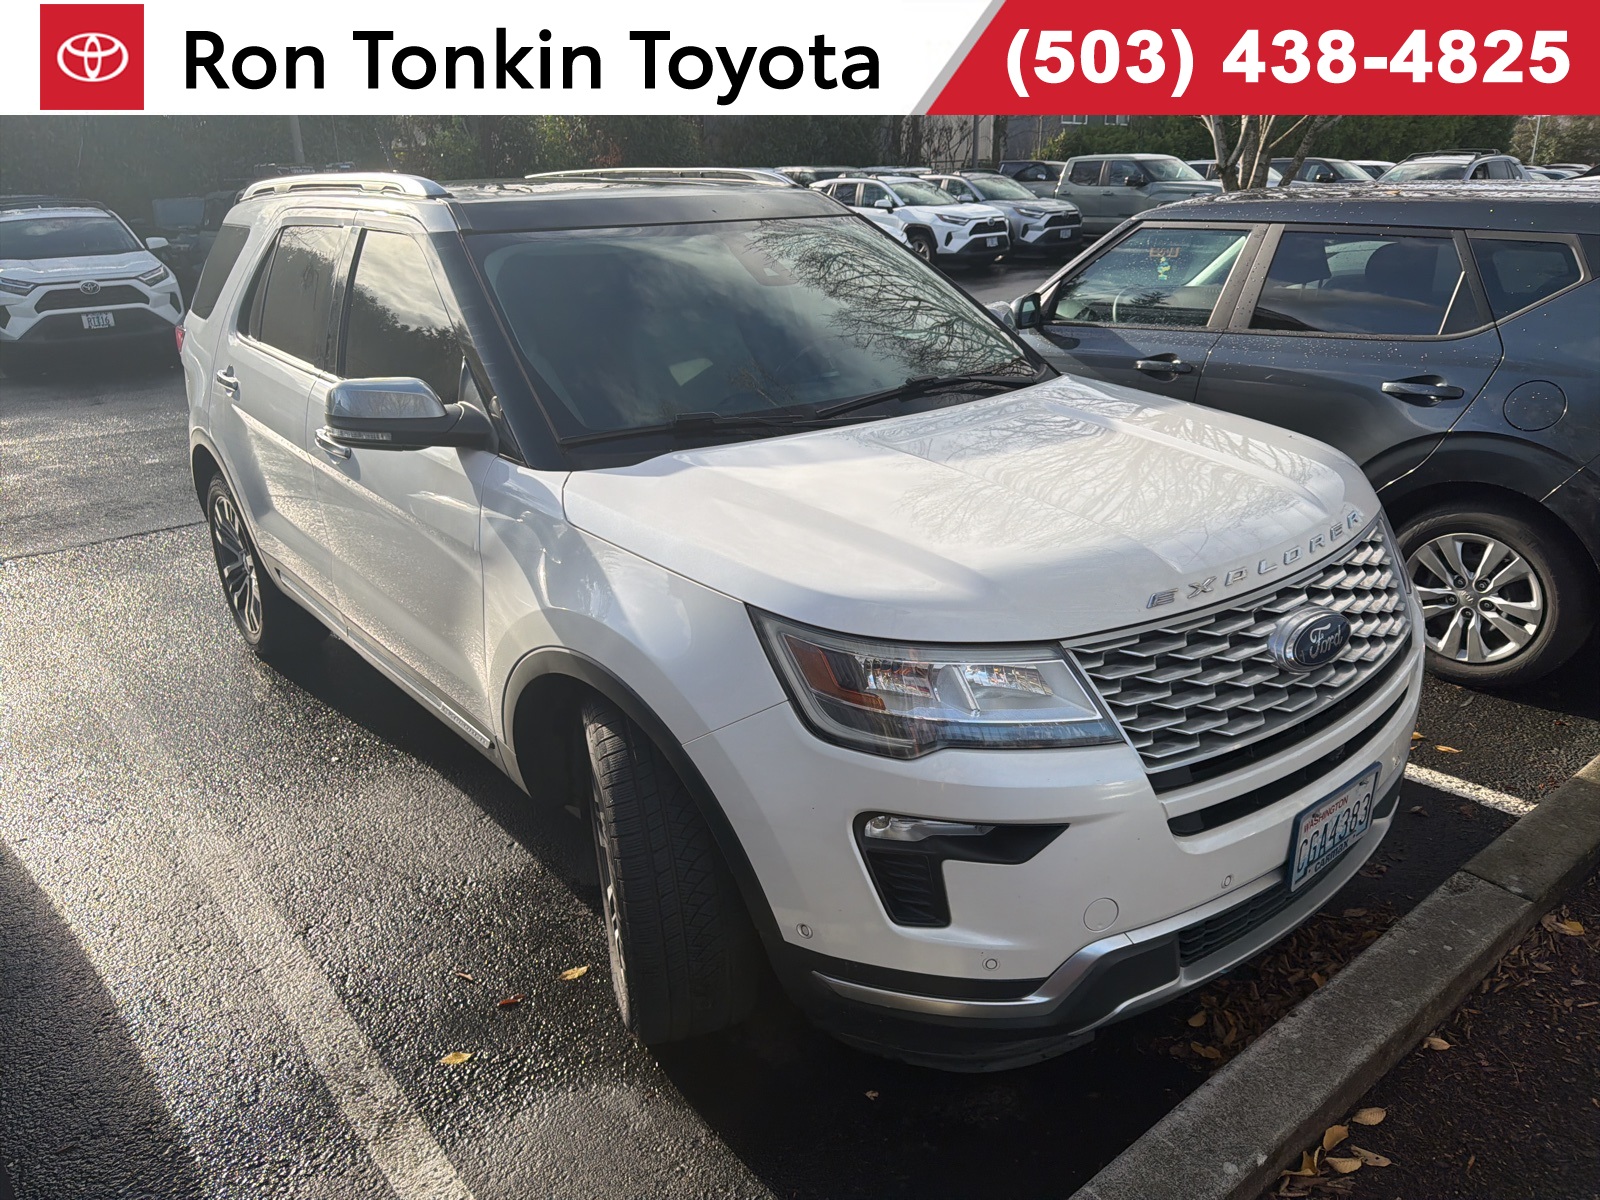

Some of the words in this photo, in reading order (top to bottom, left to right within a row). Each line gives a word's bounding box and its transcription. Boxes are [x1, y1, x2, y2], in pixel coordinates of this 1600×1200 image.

[1147, 510, 1363, 608] EXPLORER
[1309, 622, 1343, 659] Ford
[1297, 793, 1371, 874] CGA4383
[1304, 796, 1348, 832] WASHINGTON
